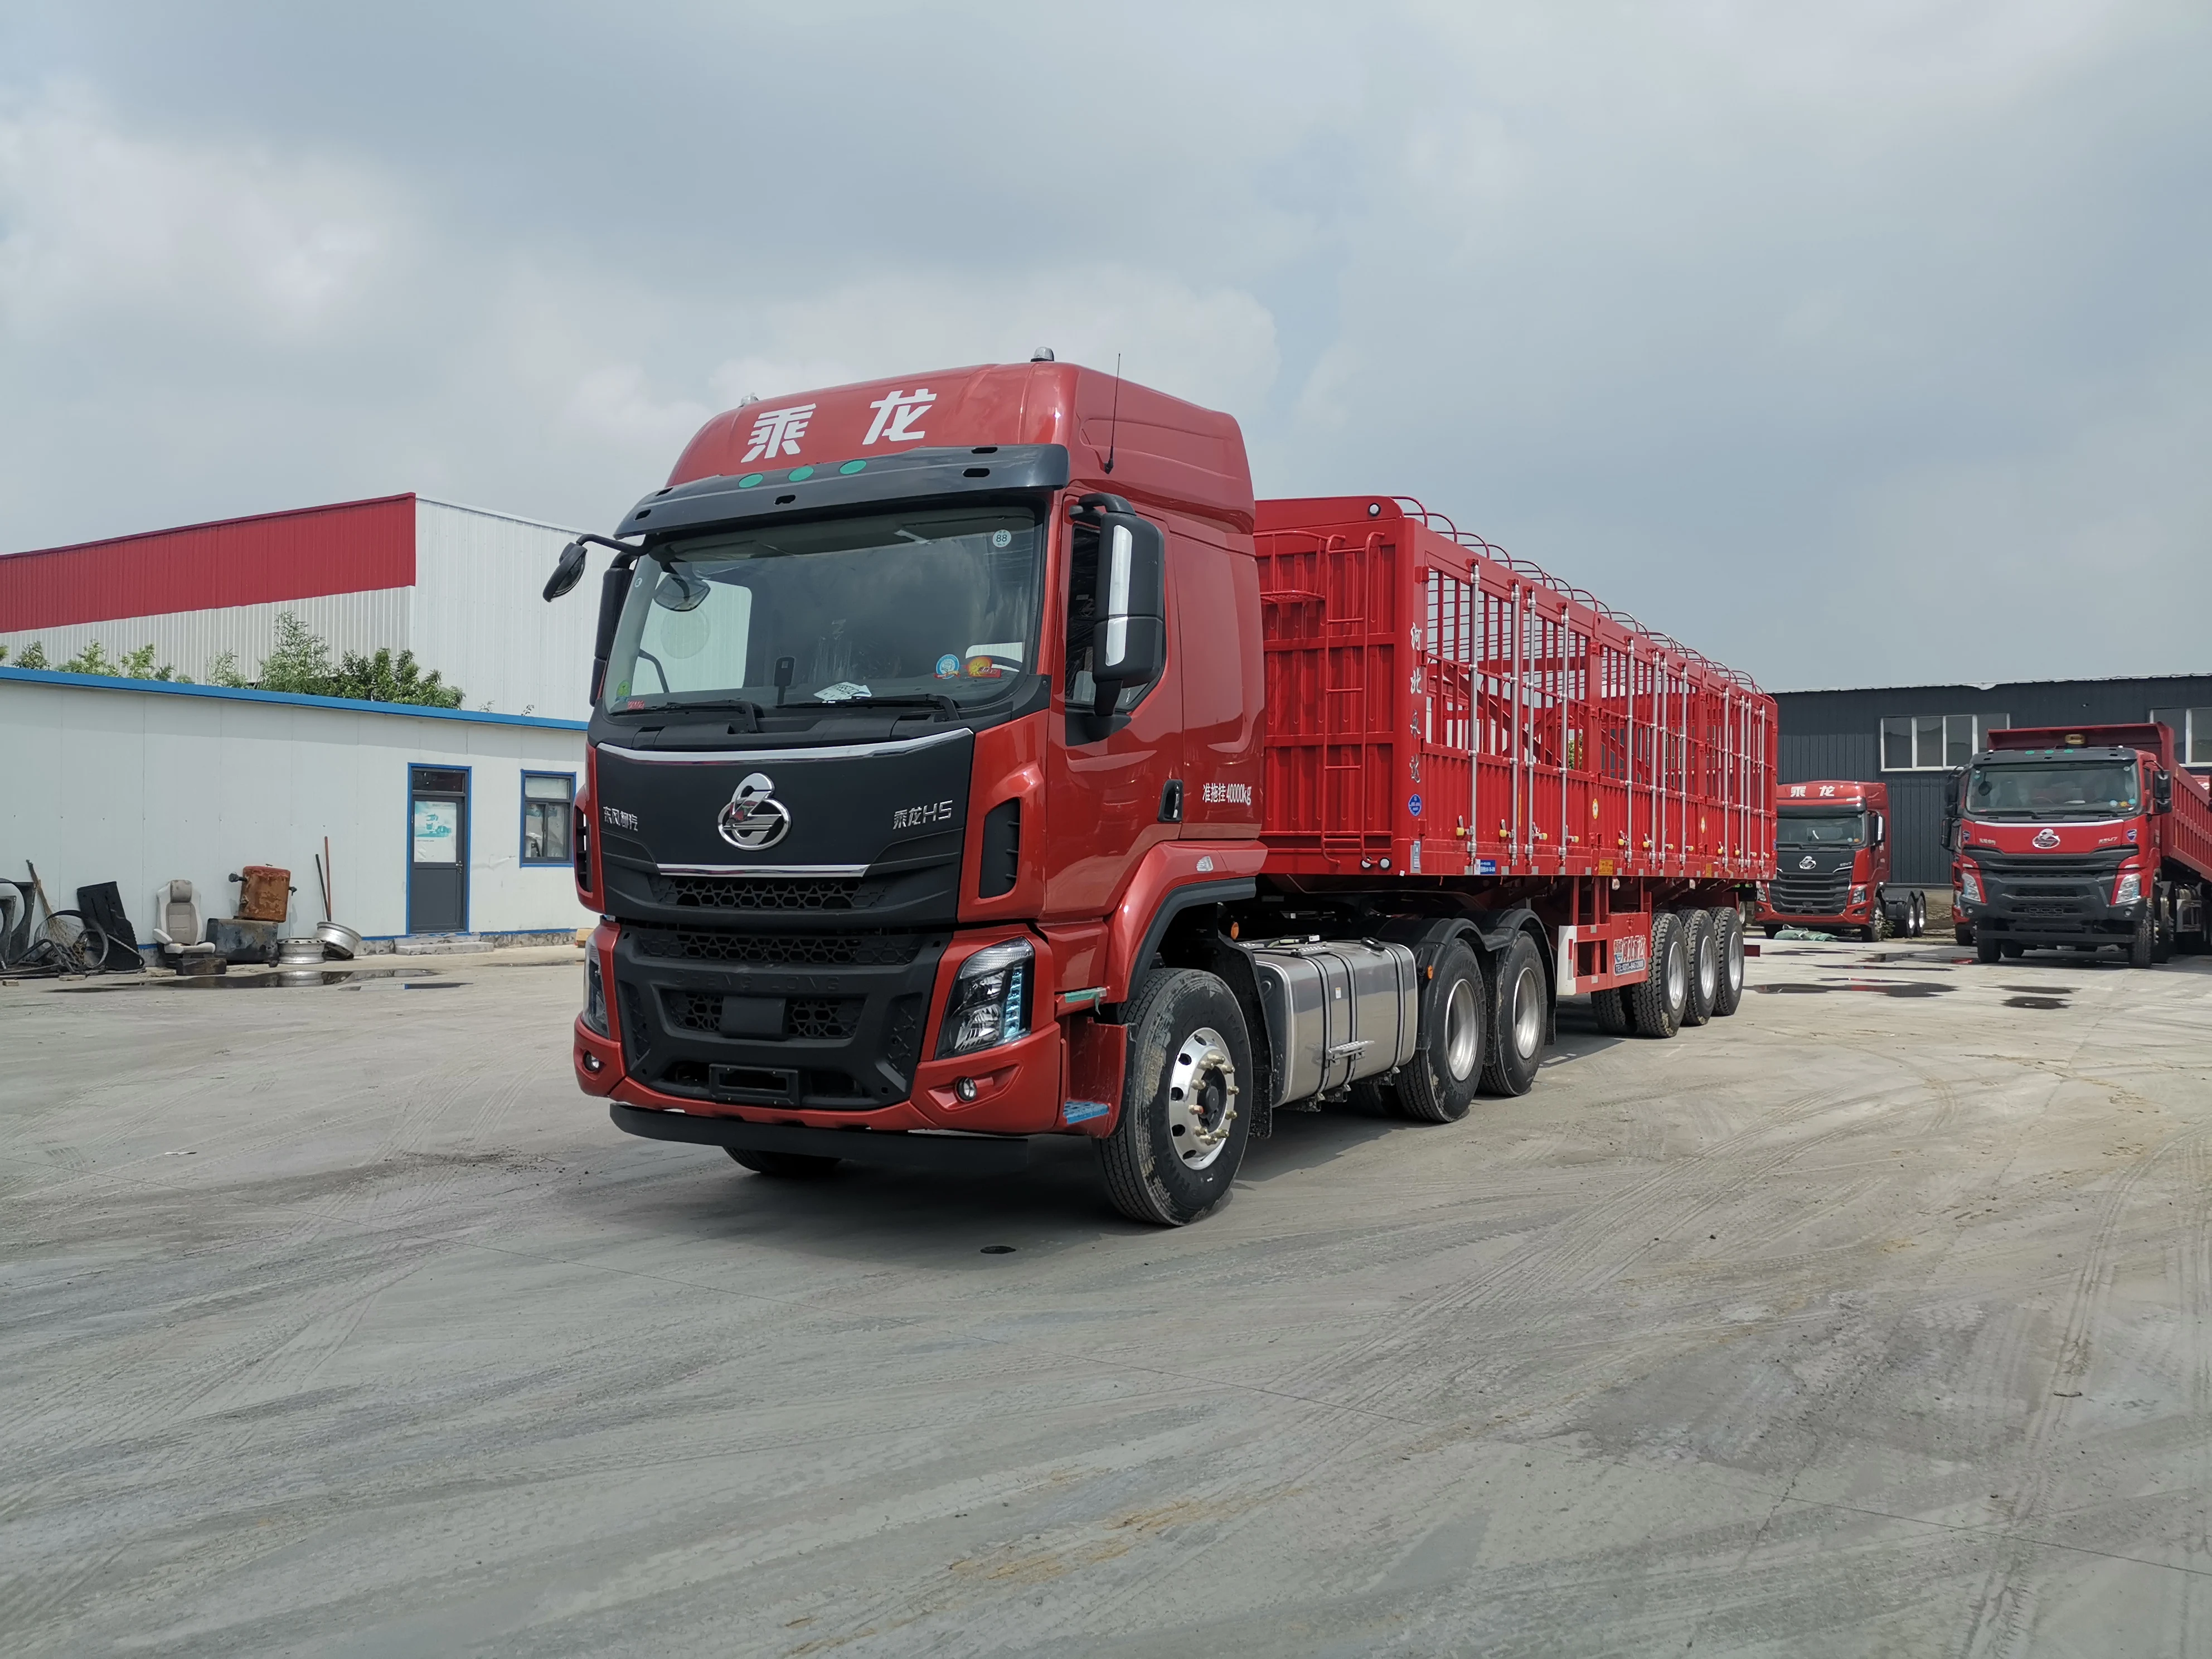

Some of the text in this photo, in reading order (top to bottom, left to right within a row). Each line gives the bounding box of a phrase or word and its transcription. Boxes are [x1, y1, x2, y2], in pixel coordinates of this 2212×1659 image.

[740, 388, 937, 463] 乘龙
[996, 534, 1007, 542] 88
[1790, 785, 1835, 798] 乘龙
